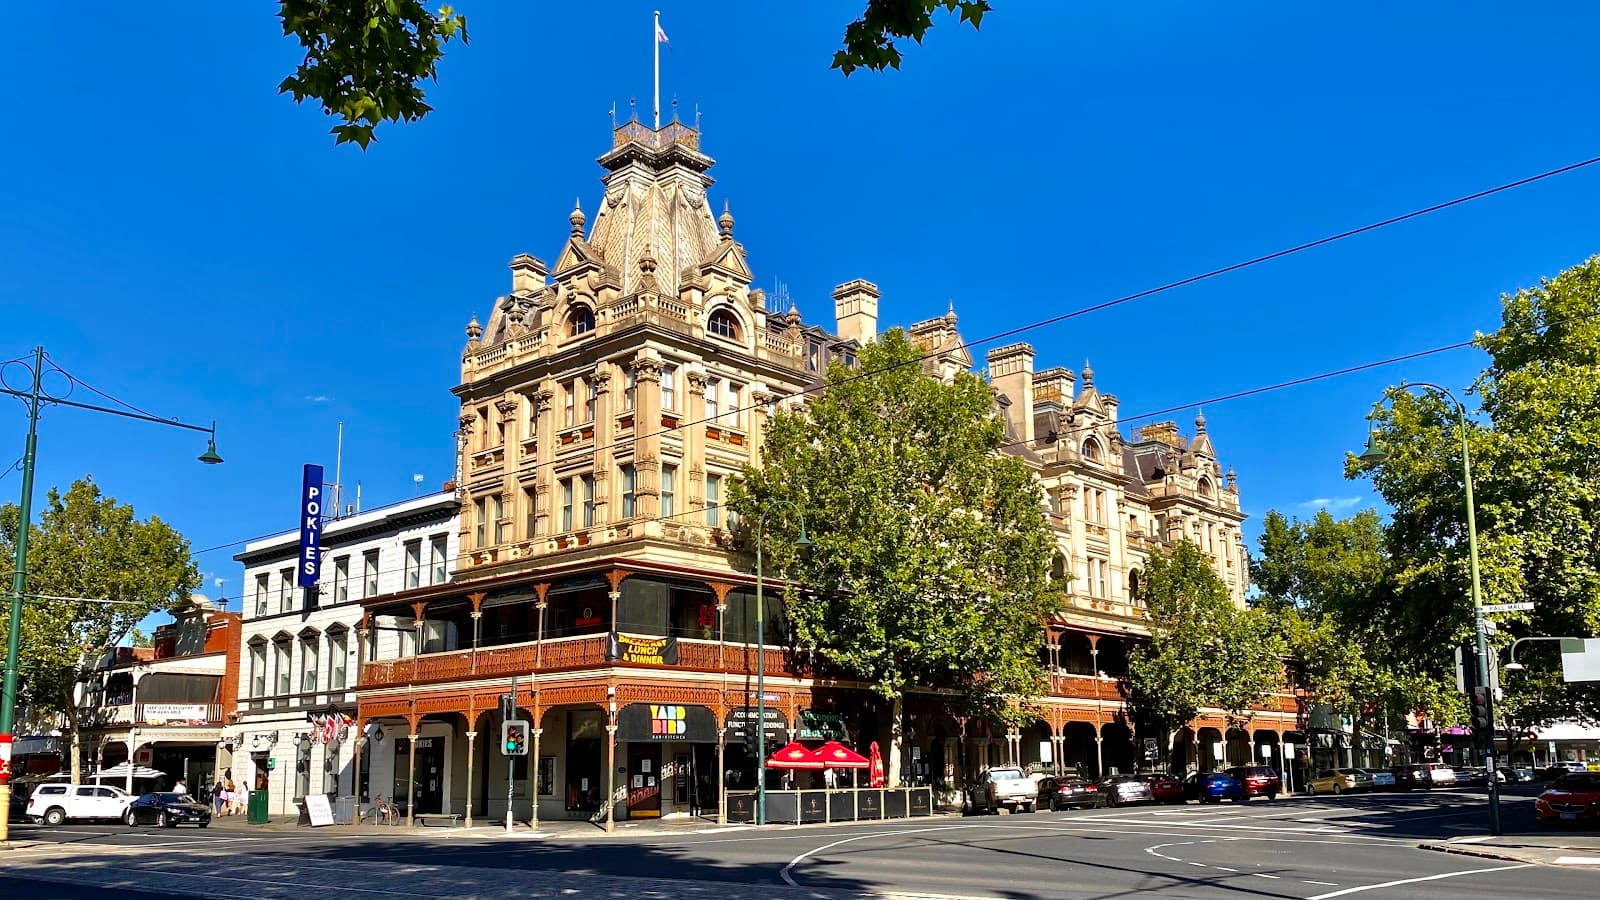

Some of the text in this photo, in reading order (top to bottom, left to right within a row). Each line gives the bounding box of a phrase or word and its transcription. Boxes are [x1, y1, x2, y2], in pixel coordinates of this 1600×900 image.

[304, 486, 319, 575] POKIES
[618, 634, 667, 647] BREAKFAST
[628, 644, 659, 655] LUNCH
[622, 652, 664, 664] & DINNER
[650, 705, 686, 720] YARD
[652, 719, 686, 734] BIRD
